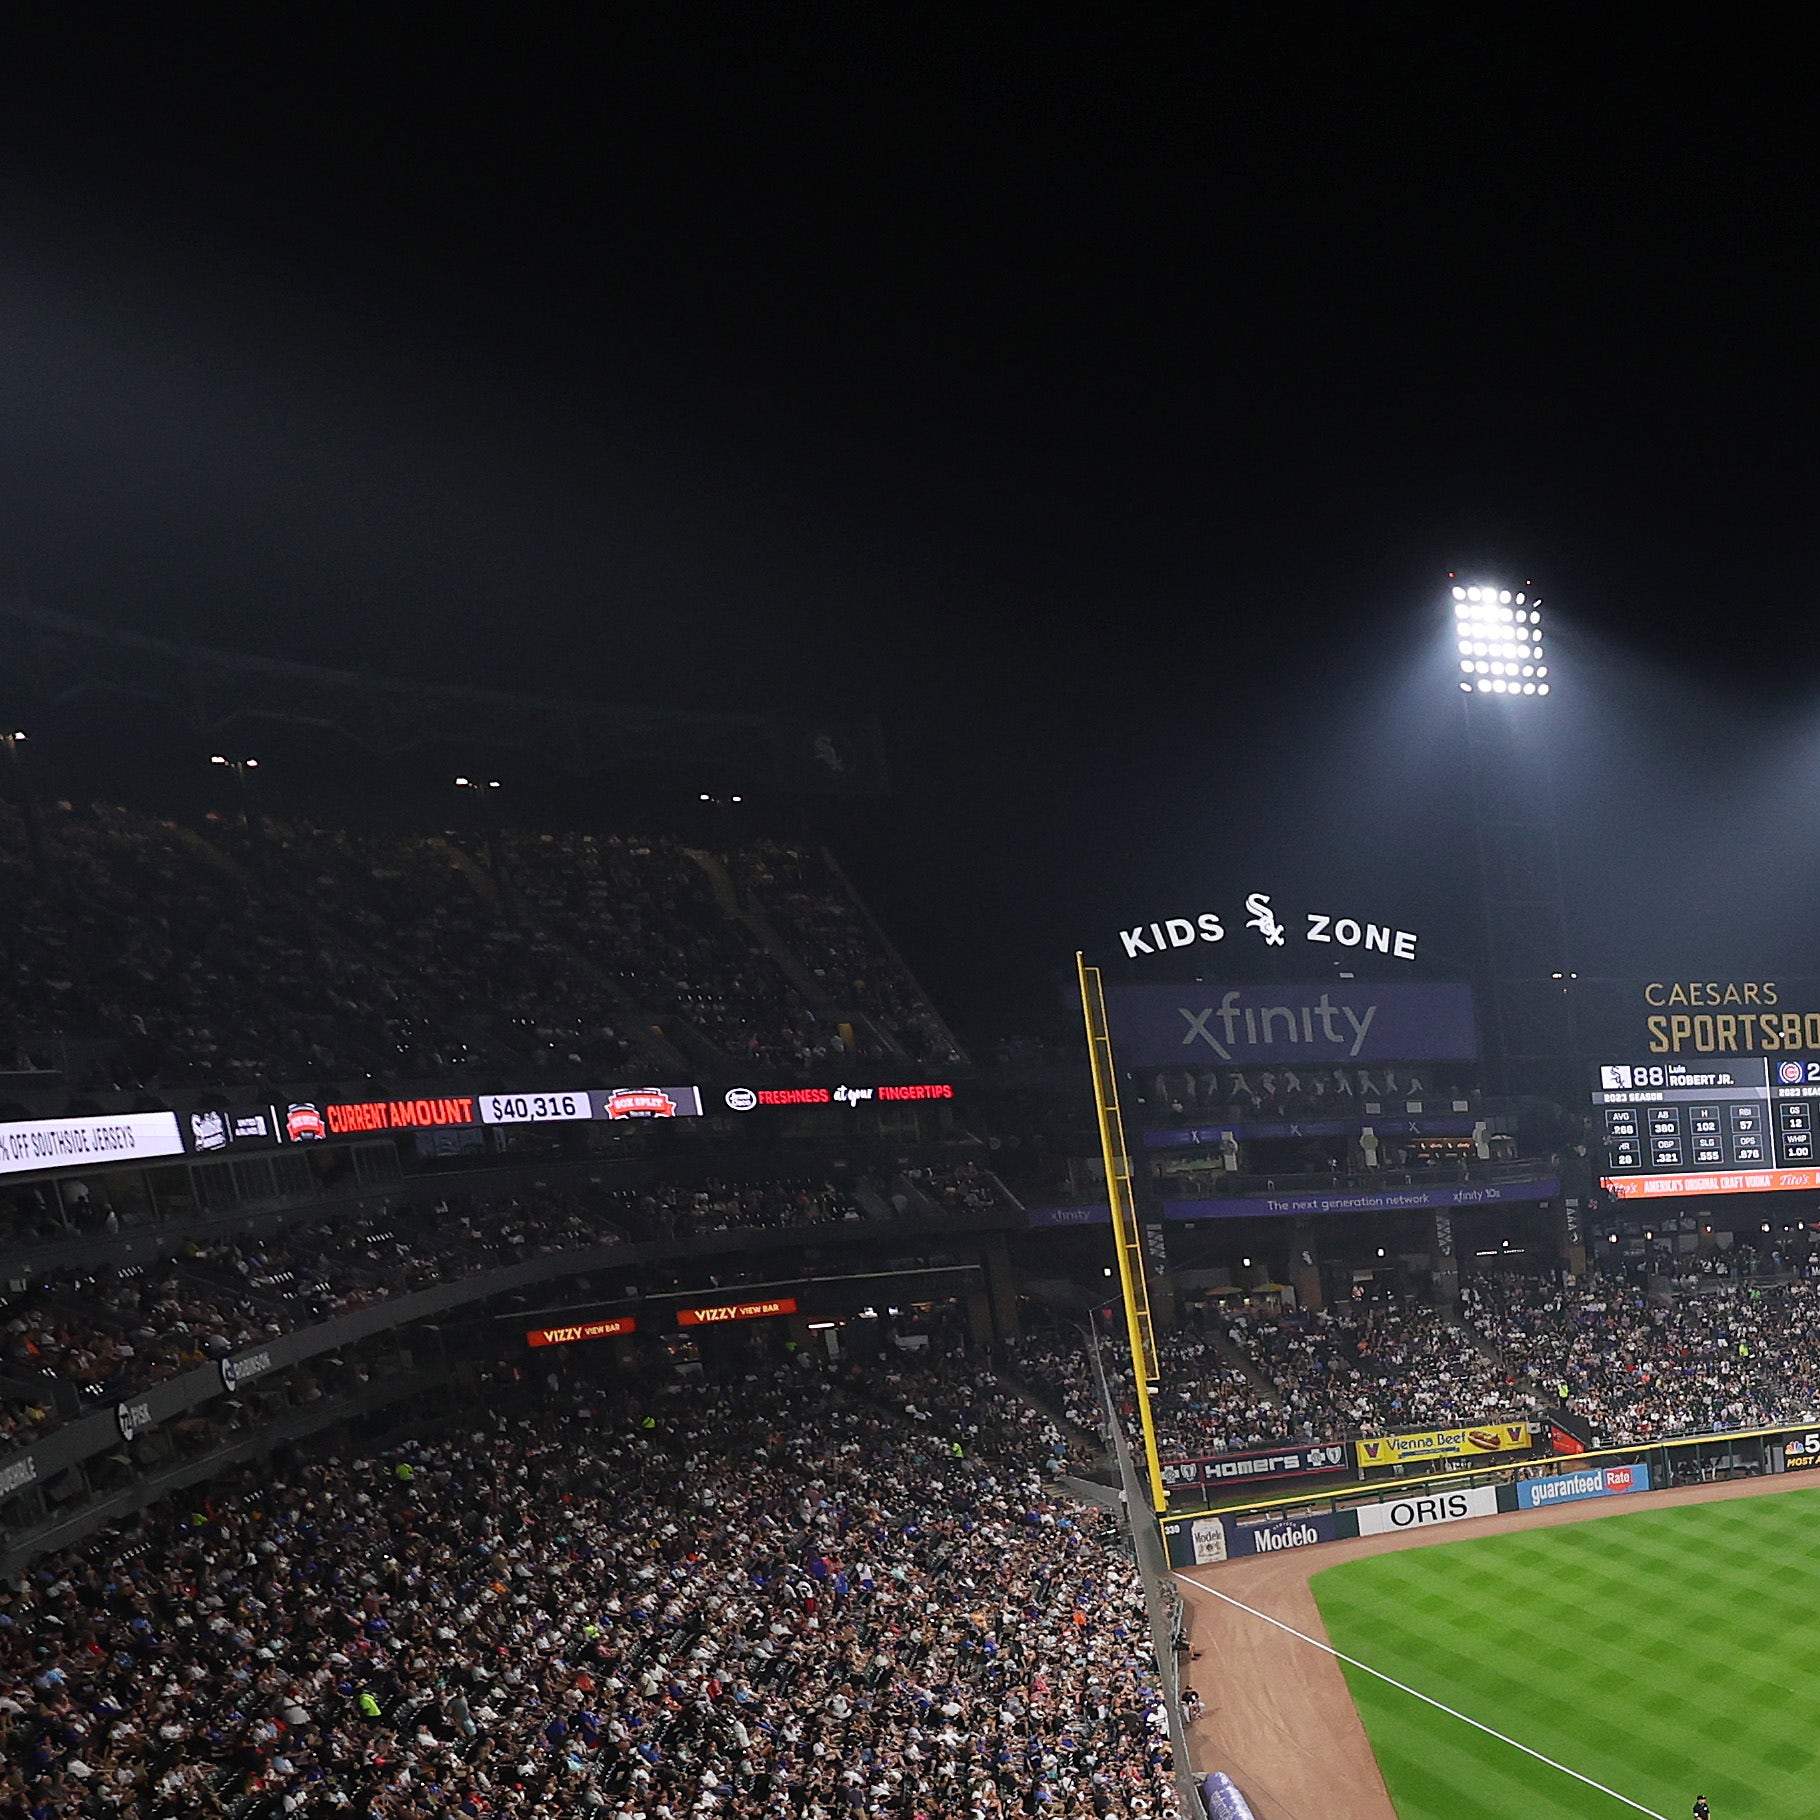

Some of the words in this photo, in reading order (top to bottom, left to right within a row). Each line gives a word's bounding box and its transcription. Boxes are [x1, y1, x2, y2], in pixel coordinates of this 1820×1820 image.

[1119, 913, 1225, 958] KIDS
[1307, 914, 1417, 960] ZONE
[1644, 983, 1778, 1007] CAESARS
[1178, 991, 1377, 1060] xfinity
[1634, 1067, 1664, 1086] 88
[1668, 1065, 1686, 1073] Luis
[1670, 1075, 1716, 1086] ROBERT
[1717, 1075, 1734, 1085] JR.
[1779, 1088, 1801, 1097] 2023
[327, 1102, 389, 1133] CURRENT
[390, 1098, 473, 1127] AMOUNT
[493, 1097, 576, 1121] $40,316
[1612, 1112, 1630, 1121] AVG
[1657, 1111, 1669, 1119] AB
[1738, 1108, 1751, 1116] RBI
[1267, 1200, 1289, 1211] The
[1321, 1195, 1383, 1212] generation
[1386, 1193, 1430, 1206] network
[694, 1306, 738, 1322] VIZZY
[739, 1305, 762, 1316] VIEW
[763, 1303, 779, 1313] BAR
[543, 1327, 583, 1343] VIZZY
[585, 1325, 605, 1335] VIEW
[605, 1323, 620, 1333] BAR
[1386, 1435, 1434, 1451] Vienna
[1436, 1431, 1467, 1446] Beef
[1786, 1457, 1814, 1468] MOST
[1530, 1470, 1603, 1507] guaranteed
[1606, 1467, 1631, 1486] Rate
[1390, 1495, 1468, 1527] ORIS
[1164, 1524, 1180, 1536] 330
[1253, 1524, 1319, 1553] Modelo
